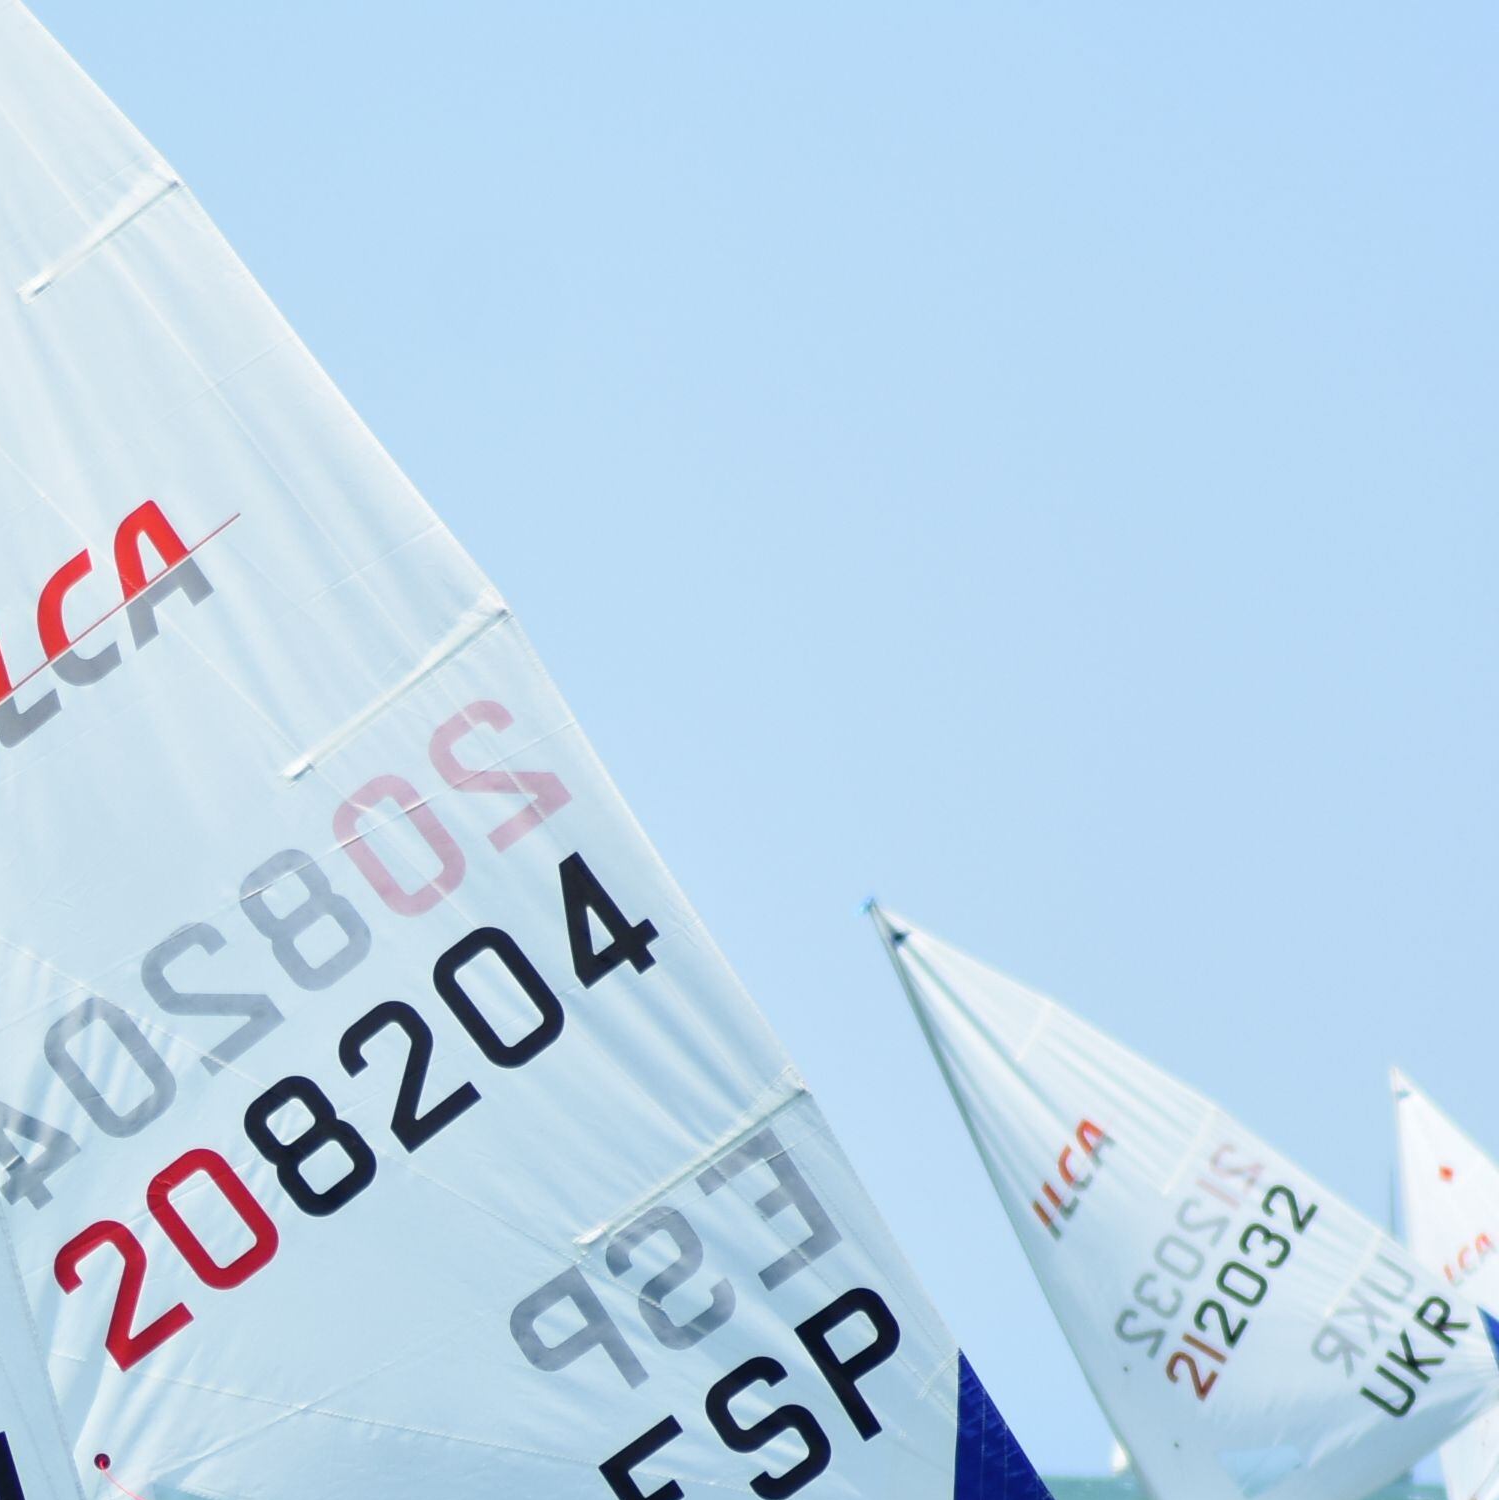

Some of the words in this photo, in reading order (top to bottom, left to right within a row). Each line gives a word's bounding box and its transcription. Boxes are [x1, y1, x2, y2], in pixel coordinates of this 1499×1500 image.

[53, 851, 659, 1372] 208204
[1032, 1118, 1115, 1241] ILCA
[1167, 1184, 1319, 1401] 212032
[1443, 1232, 1498, 1288] LCA
[1360, 1295, 1471, 1418] UKR
